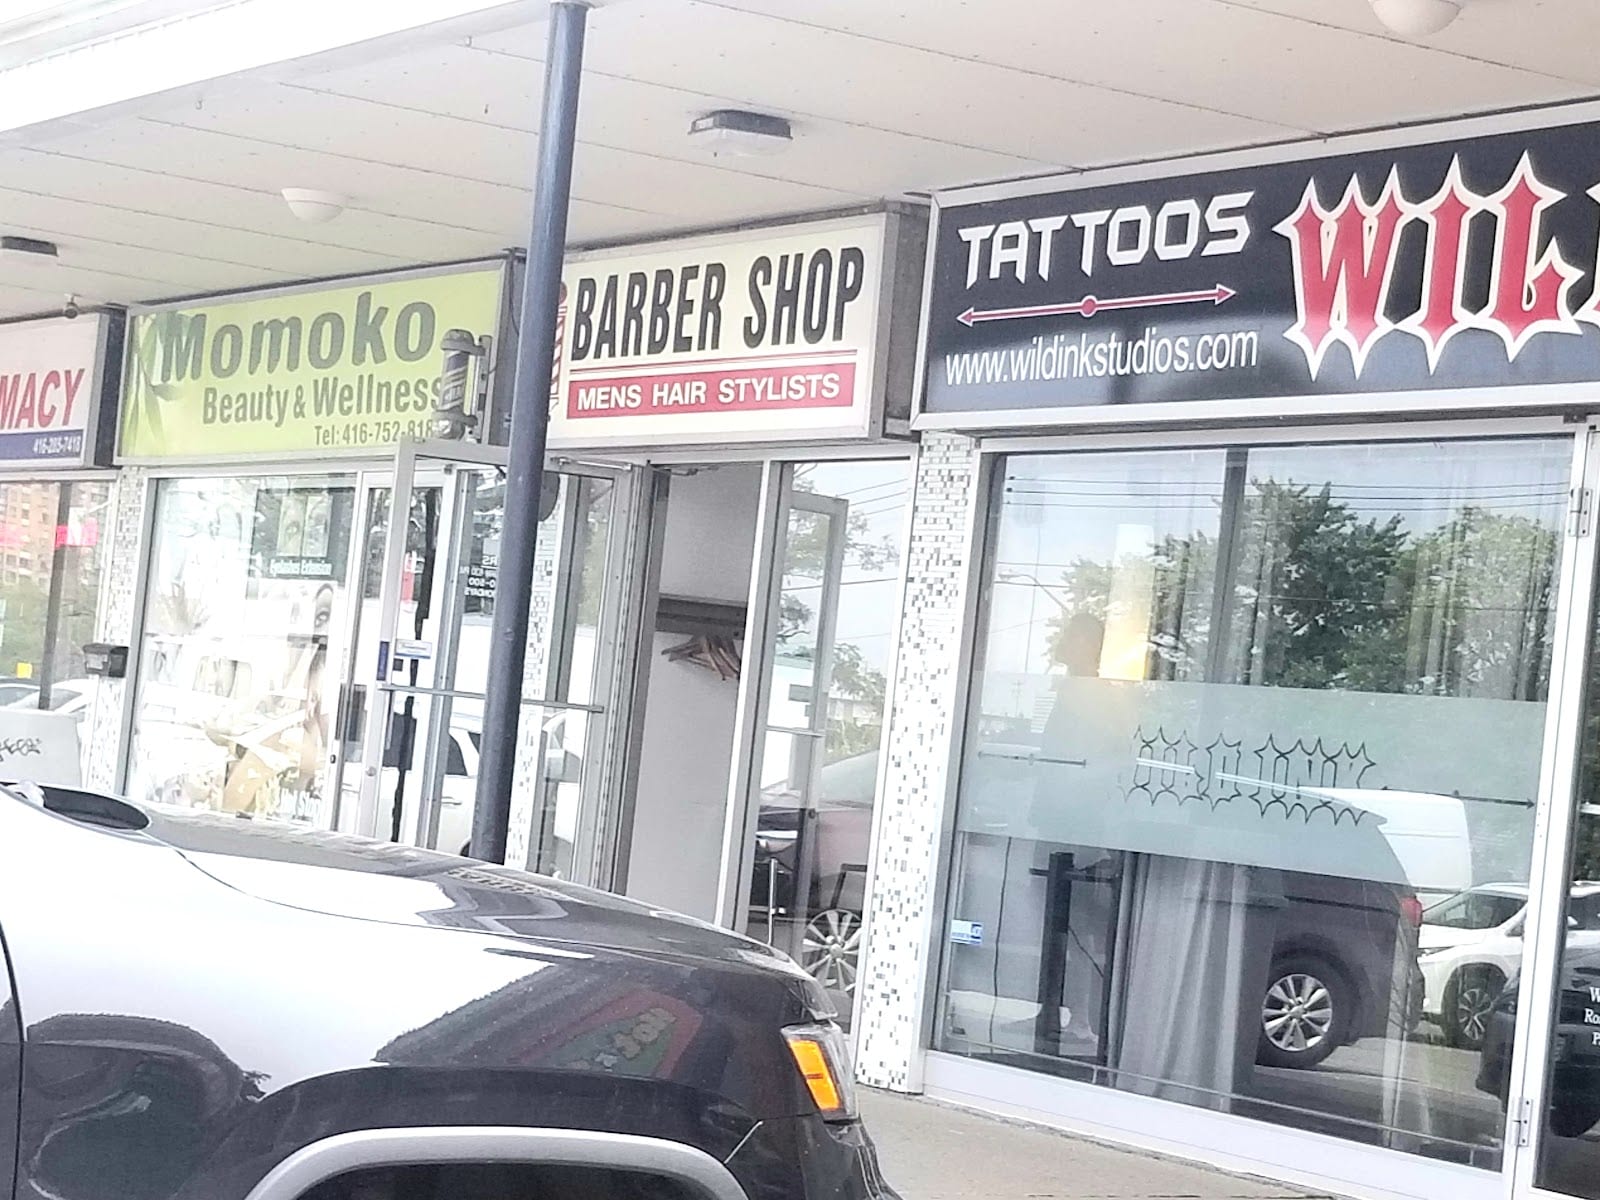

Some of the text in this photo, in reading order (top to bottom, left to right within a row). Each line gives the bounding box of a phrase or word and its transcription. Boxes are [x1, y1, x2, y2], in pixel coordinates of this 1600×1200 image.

[958, 190, 1257, 290] TATTOOS
[1273, 149, 1600, 382] WIL
[159, 291, 436, 383] Momoko
[571, 246, 865, 361] BARBER SHOP
[577, 372, 840, 411] MENS HAIR STYLISTS
[945, 326, 1258, 386] www.wildinkstudios.com
[202, 384, 291, 428] Beauty
[292, 394, 306, 419] &
